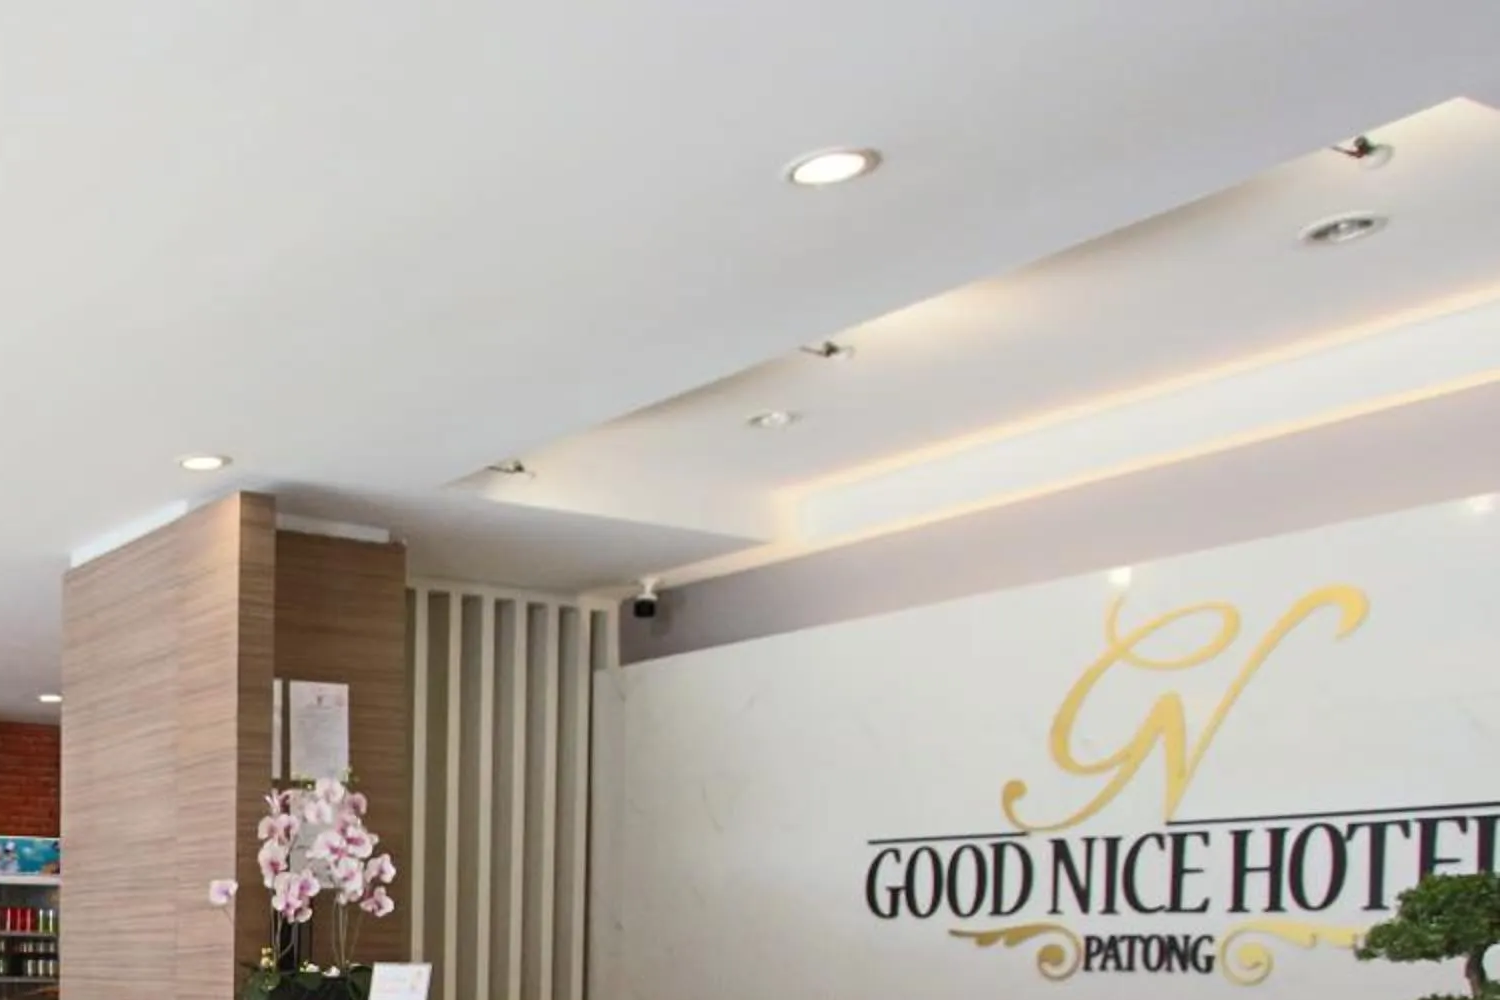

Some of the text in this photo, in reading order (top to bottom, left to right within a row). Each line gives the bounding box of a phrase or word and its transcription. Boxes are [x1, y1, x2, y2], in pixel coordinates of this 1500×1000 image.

[865, 841, 1034, 919] GOOD
[1047, 831, 1211, 915] NICE
[1082, 934, 1217, 973] PATONG
